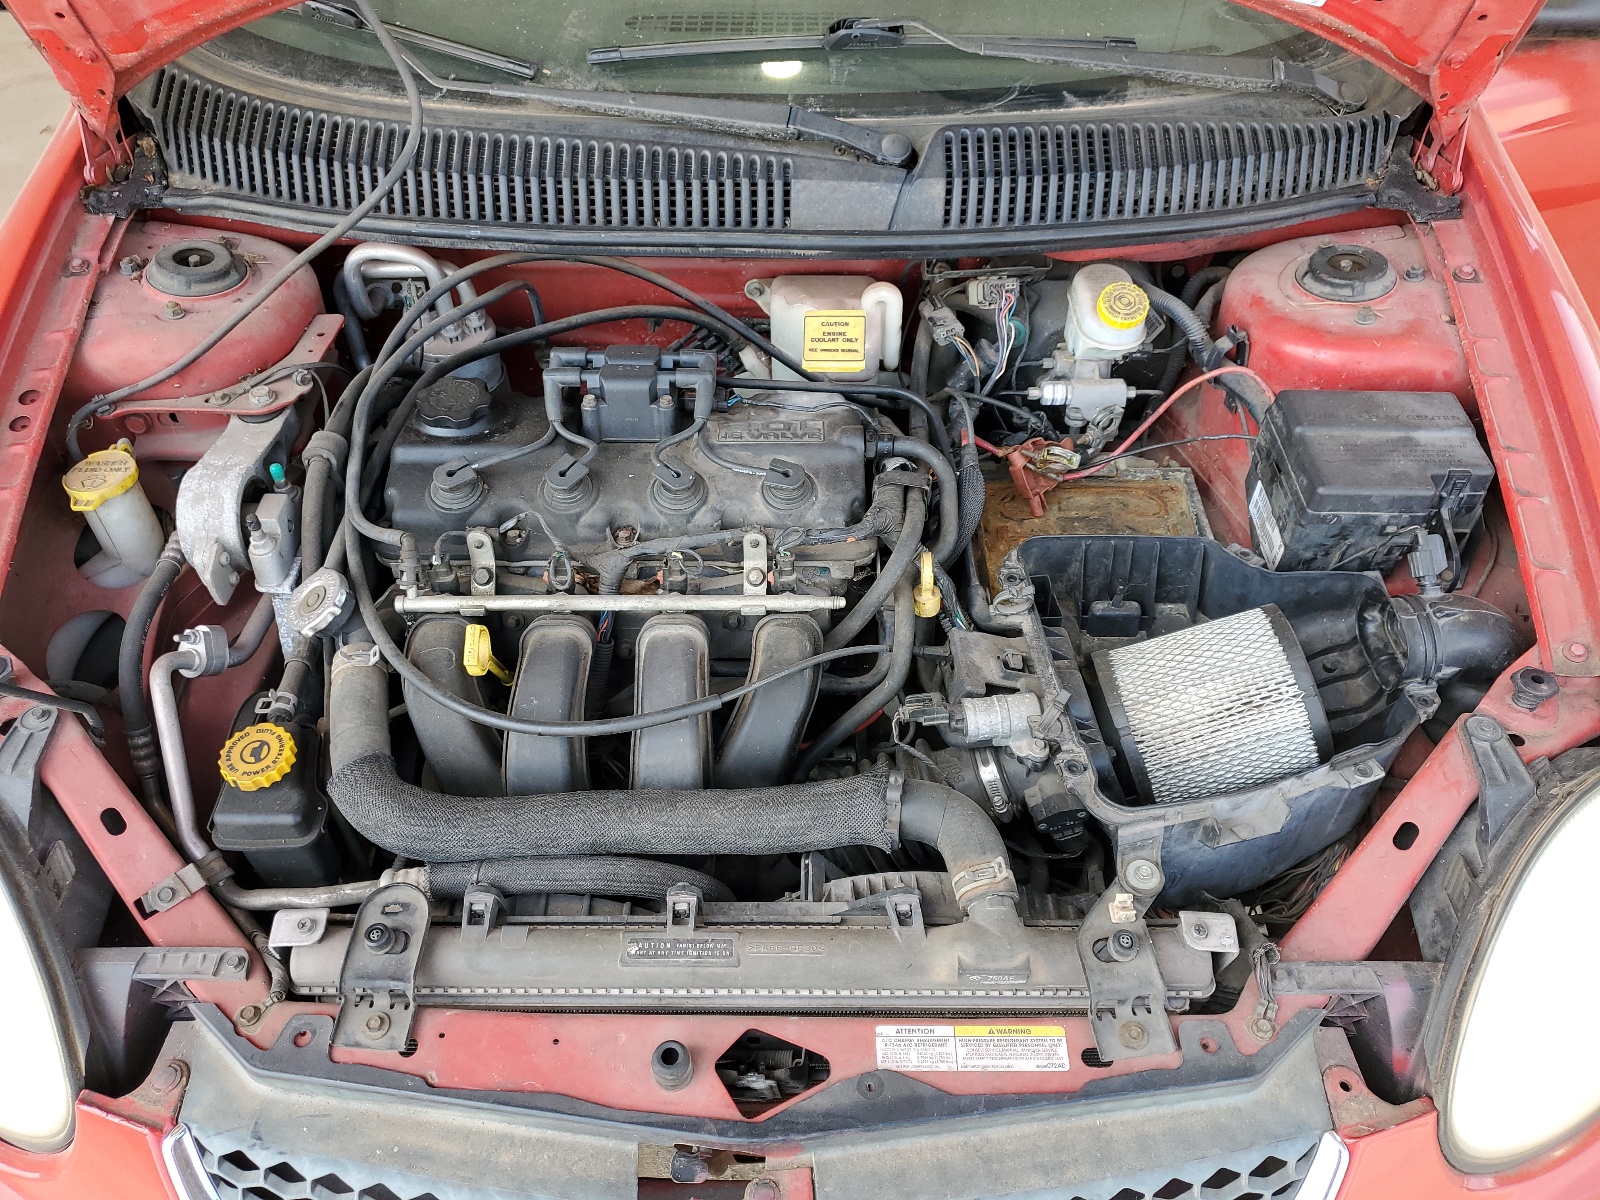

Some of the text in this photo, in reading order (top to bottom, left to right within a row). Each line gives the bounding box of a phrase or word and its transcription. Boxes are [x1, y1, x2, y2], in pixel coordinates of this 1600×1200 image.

[746, 431, 822, 440] VALVE
[255, 728, 278, 736] FLUID
[225, 731, 251, 762] APPROVED
[271, 734, 286, 765] STEERING
[226, 762, 239, 774] USE
[241, 764, 272, 777] POWER
